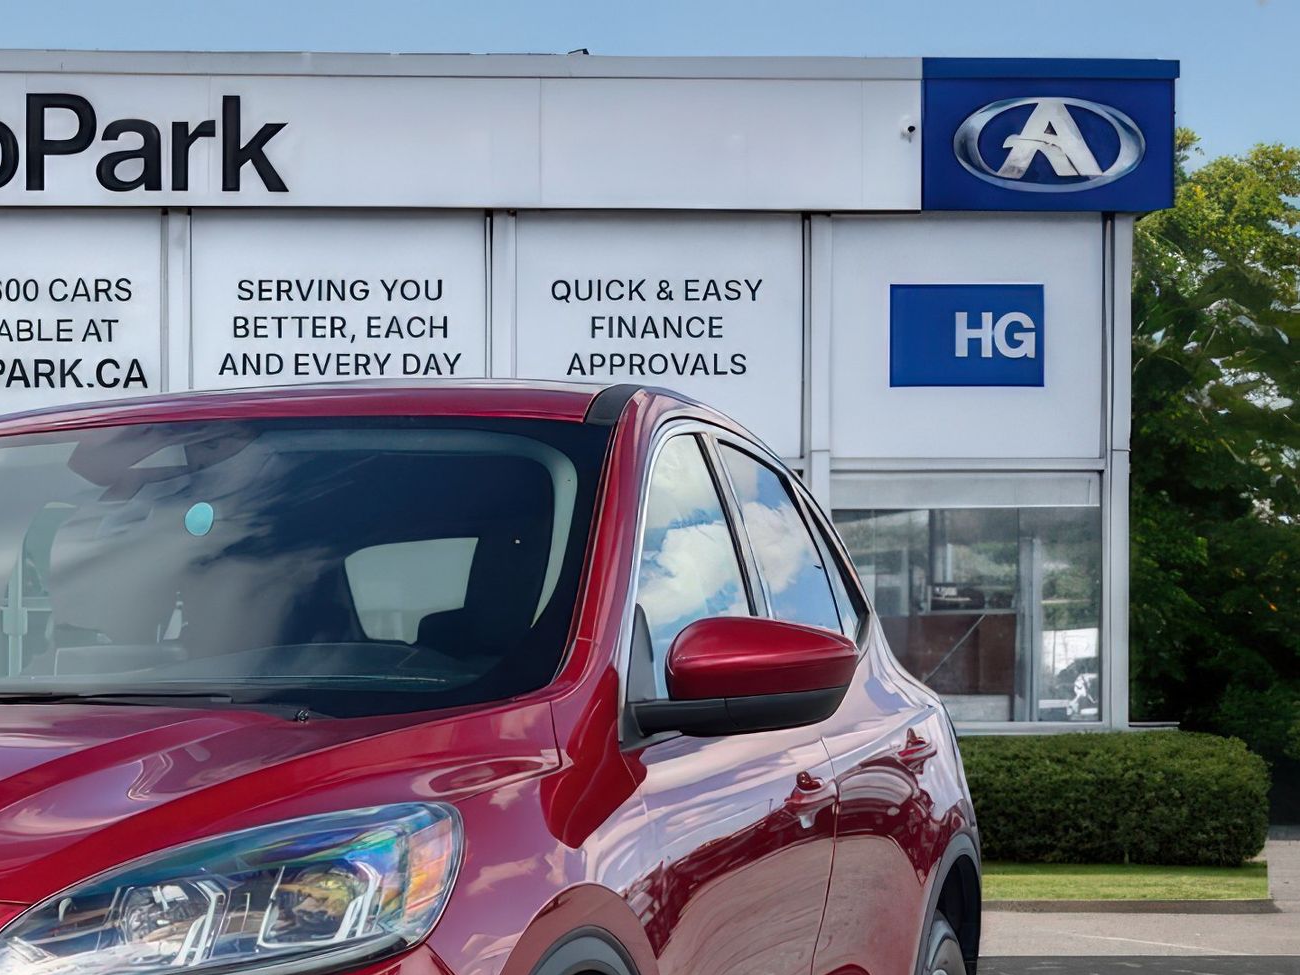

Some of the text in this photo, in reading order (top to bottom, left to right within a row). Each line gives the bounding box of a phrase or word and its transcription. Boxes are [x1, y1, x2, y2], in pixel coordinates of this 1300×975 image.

[48, 277, 132, 303] CARS
[237, 279, 443, 302] SERVING YOU
[551, 278, 763, 303] QUICK & EASY
[81, 318, 119, 343] AT
[233, 315, 448, 344] BETTER, EACH
[591, 315, 723, 339] FINANCE
[955, 311, 1036, 358] HG
[218, 352, 462, 376] AND EVERY DAY
[566, 352, 747, 376] APPROVALS
